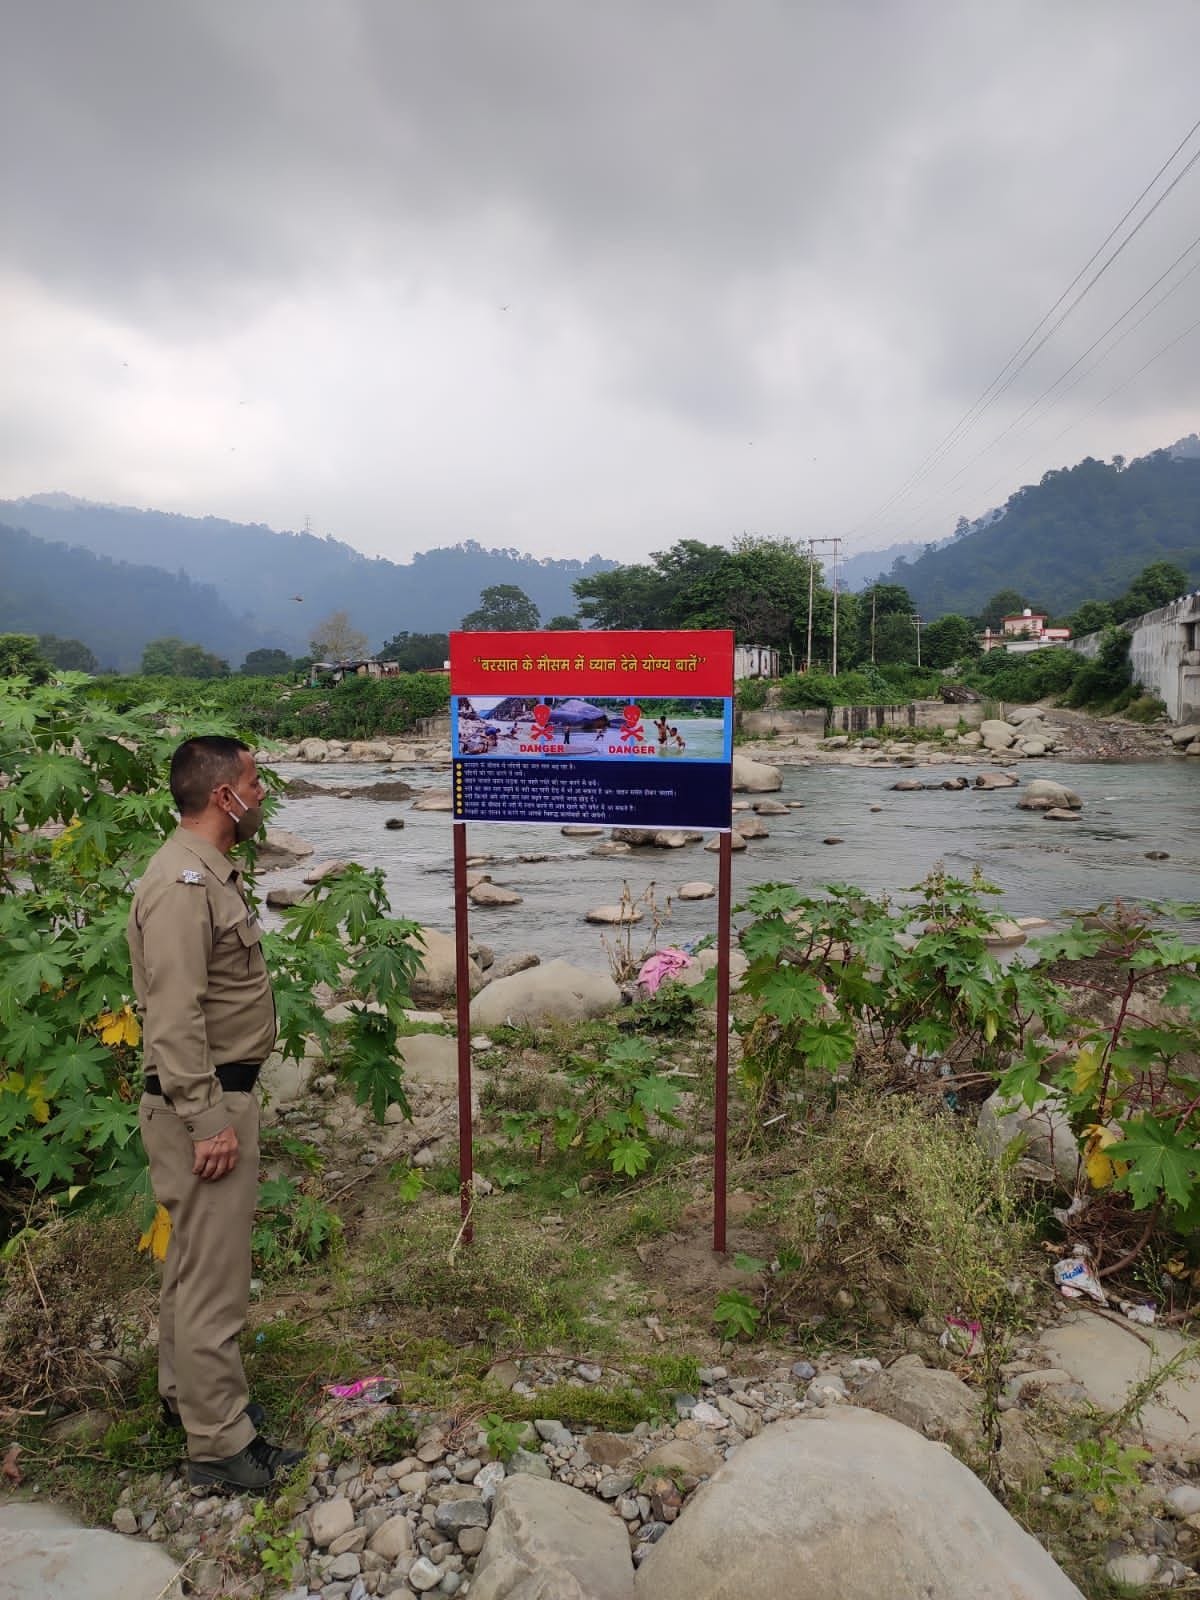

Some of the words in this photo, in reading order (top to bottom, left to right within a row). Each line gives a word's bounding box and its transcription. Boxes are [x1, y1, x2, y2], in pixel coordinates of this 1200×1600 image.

[522, 655, 533, 671] के
[537, 654, 570, 671] मौसम
[574, 654, 585, 671] में
[621, 654, 638, 671] देने
[642, 654, 671, 671] योग्य
[520, 744, 564, 753] DANGER
[608, 746, 655, 754] DANGER
